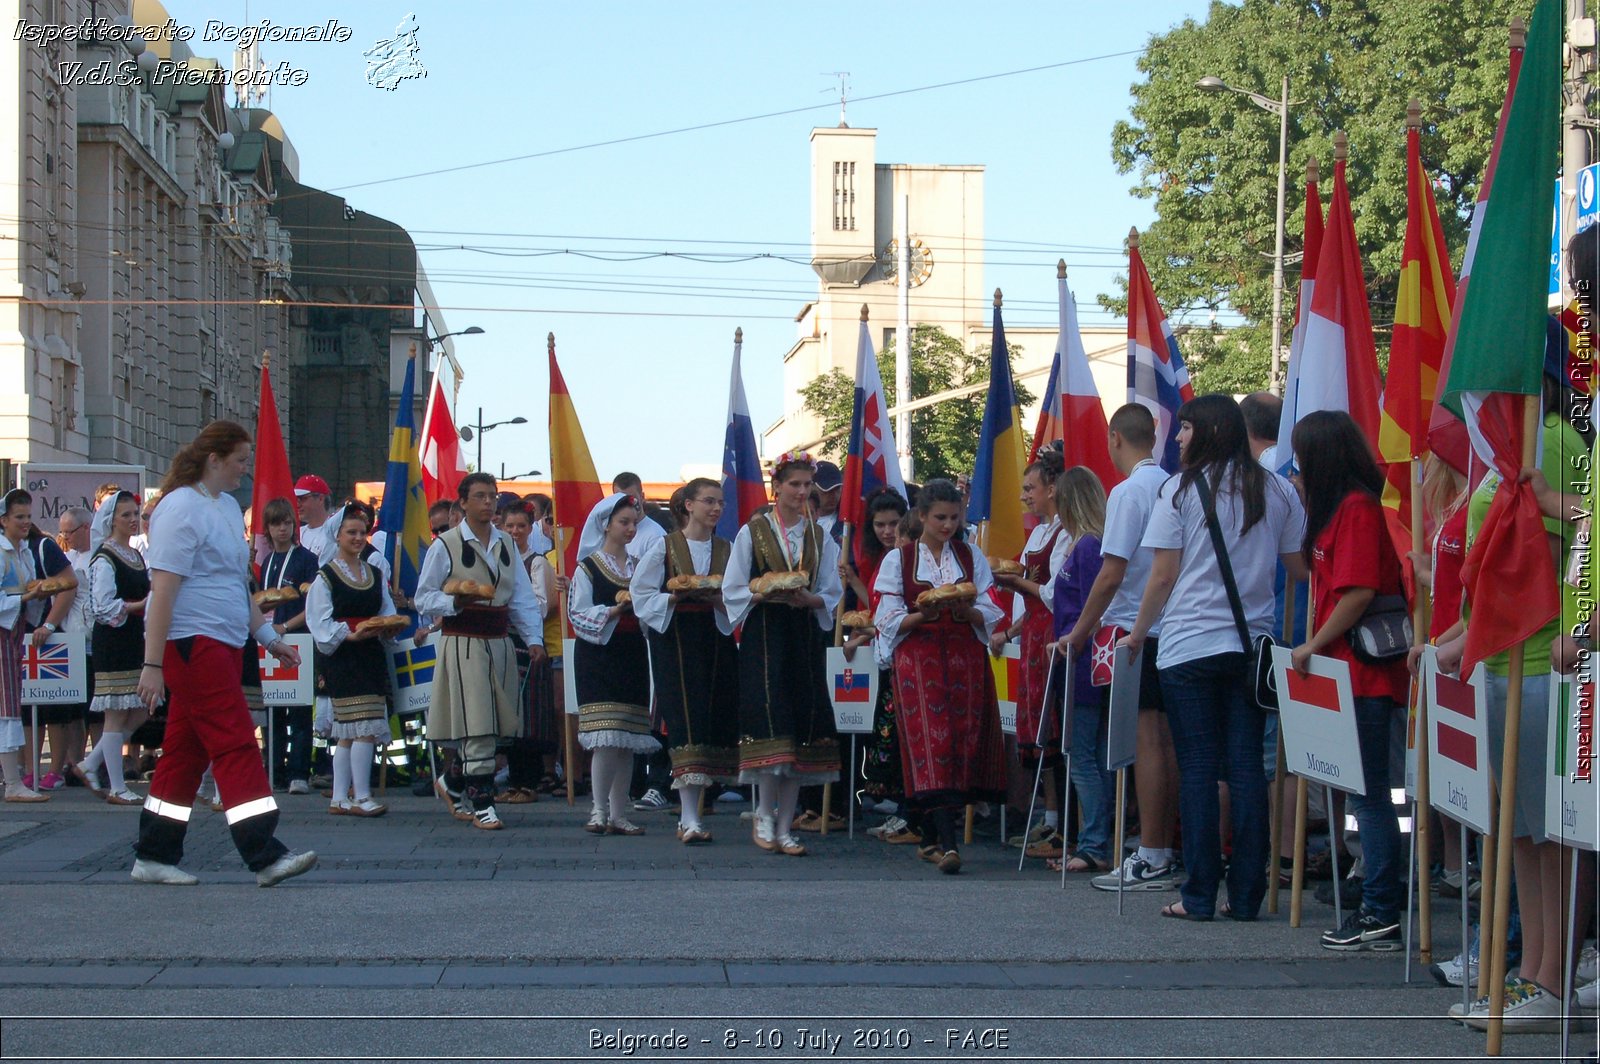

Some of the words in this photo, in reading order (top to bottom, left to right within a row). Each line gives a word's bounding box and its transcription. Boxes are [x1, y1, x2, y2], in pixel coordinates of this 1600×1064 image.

[30, 687, 80, 700] Kingdom
[840, 712, 864, 725] Slovakia
[1306, 752, 1340, 778] Monaco
[1447, 781, 1468, 811] Latvia
[1564, 800, 1578, 835] Italy
